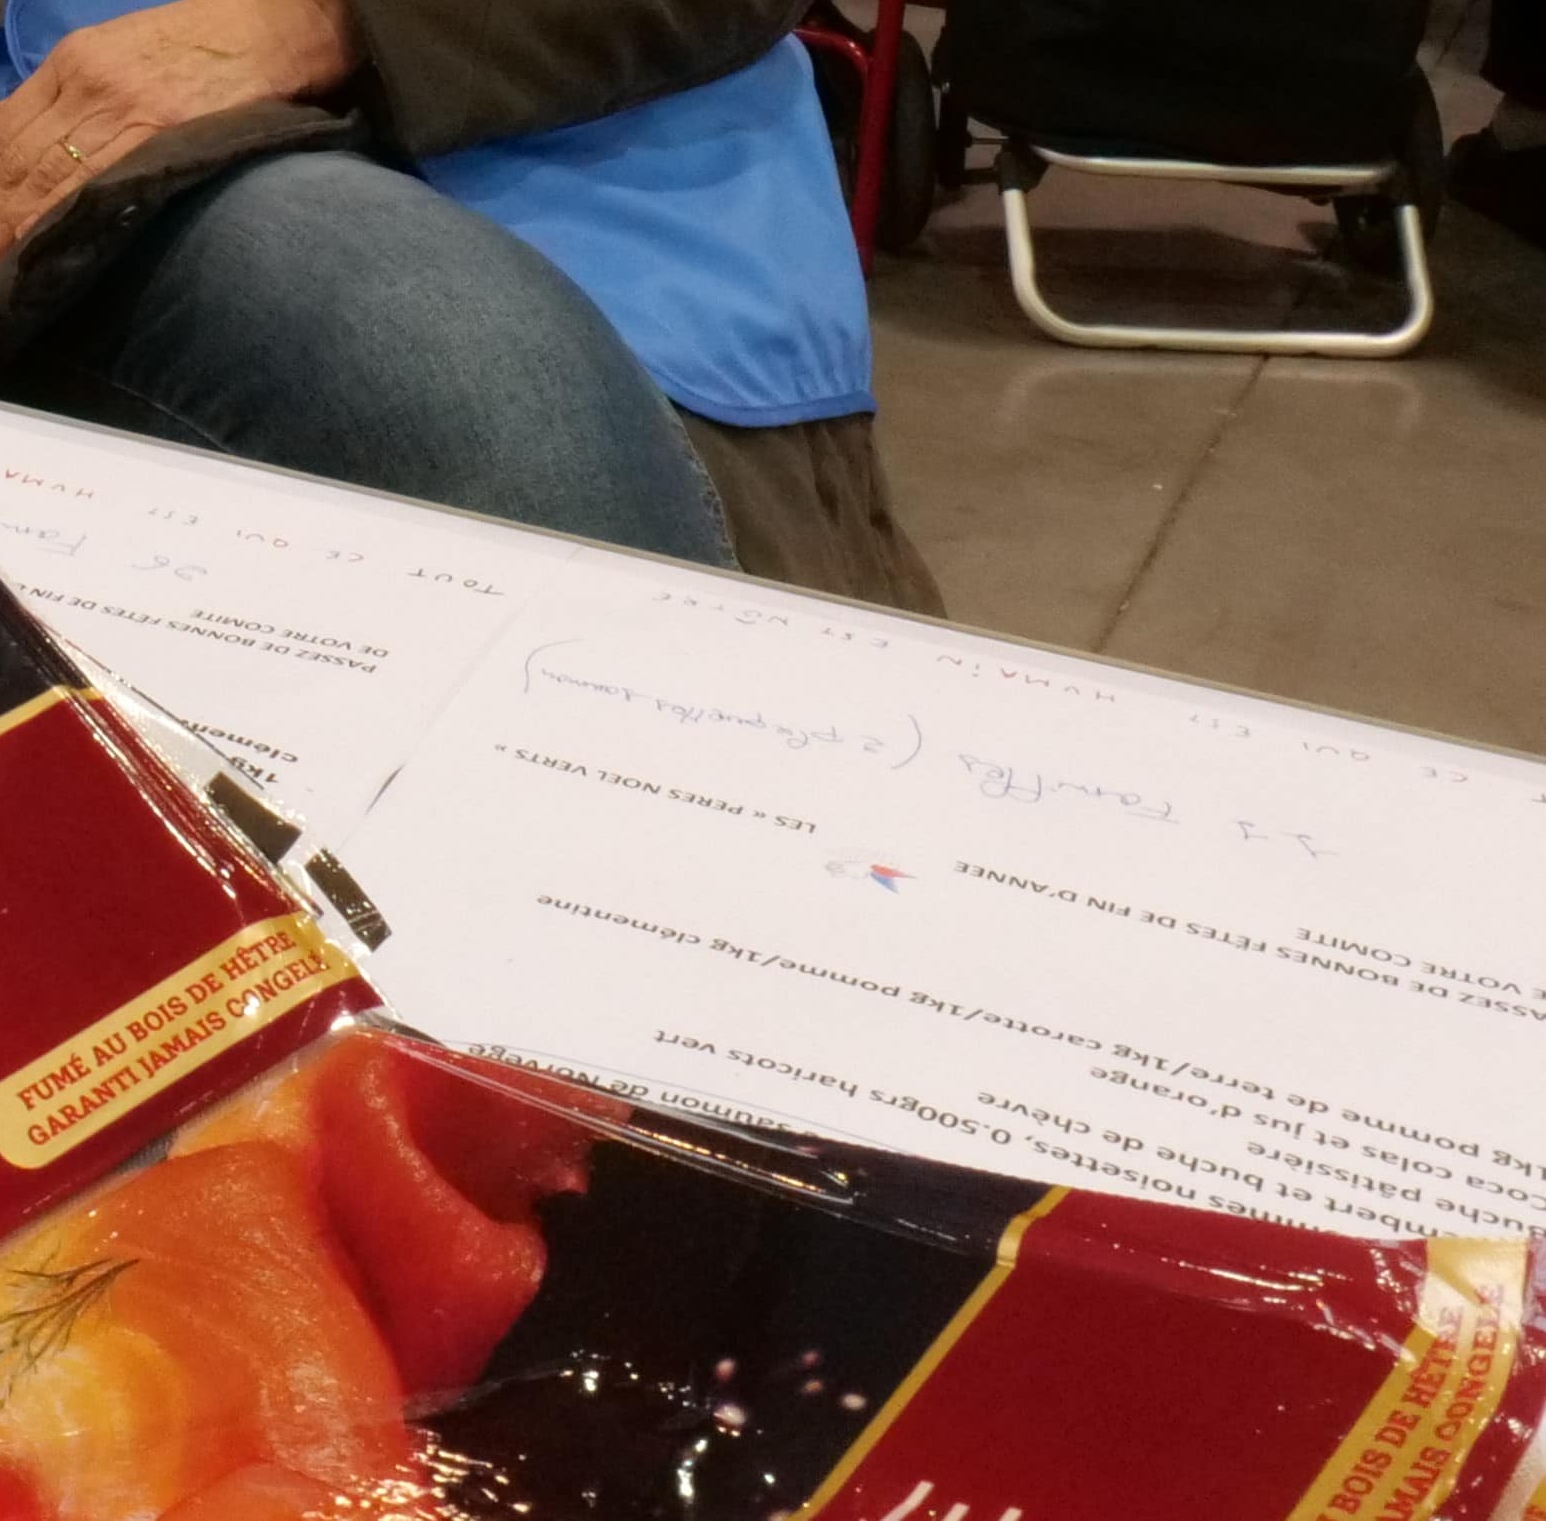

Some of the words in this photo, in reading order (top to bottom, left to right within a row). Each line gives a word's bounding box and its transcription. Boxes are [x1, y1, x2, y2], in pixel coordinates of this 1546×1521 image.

[30, 588, 64, 601] FIN
[68, 598, 97, 610] DE
[169, 621, 256, 647] BONNES
[192, 611, 275, 645] COMITE
[263, 643, 290, 655] DE
[282, 630, 353, 661] VOTRE
[295, 638, 376, 673] PASSEZ
[362, 646, 388, 657] DE
[516, 750, 586, 776] VERTS
[598, 770, 661, 794] NOEL
[669, 789, 743, 815] PERES
[775, 816, 816, 833] LES
[537, 896, 700, 944] clémentine
[1087, 897, 1130, 917] FIN
[1144, 912, 1176, 929] DE
[1298, 929, 1411, 967] COMITE
[710, 939, 900, 997] pomme/1kg
[1277, 947, 1399, 986] BONNES
[1425, 963, 1521, 994] VOTRE
[1415, 983, 1448, 998] DE
[1456, 989, 1546, 1023] ASSEZ
[16, 1055, 92, 1112] FUMÉ
[93, 1034, 128, 1067] AU
[125, 995, 189, 1042] BOIS
[185, 972, 224, 1006] DE
[220, 930, 298, 982] HÊTRE
[909, 992, 1102, 1050] carotte/1kg
[655, 1031, 715, 1054] vert
[27, 1066, 143, 1147] GARANTI
[144, 1012, 227, 1079] JAMAIS
[728, 1050, 858, 1097] haricots
[1113, 1044, 1274, 1100] terre/1kg
[606, 1075, 649, 1101] de
[978, 1093, 1090, 1133] chèvre
[1287, 1095, 1329, 1114] de
[1103, 1131, 1144, 1151] de
[1254, 1114, 1304, 1139] jus
[1315, 1131, 1350, 1149] et
[1342, 1110, 1479, 1157] pomme
[1025, 1137, 1197, 1202] noisettes,
[1157, 1147, 1263, 1192] buche
[1247, 1142, 1421, 1202] pâtissière
[1363, 1146, 1452, 1179] colas
[1276, 1183, 1312, 1201] et
[1327, 1448, 1393, 1515] BOIS
[1374, 1409, 1422, 1449] DE
